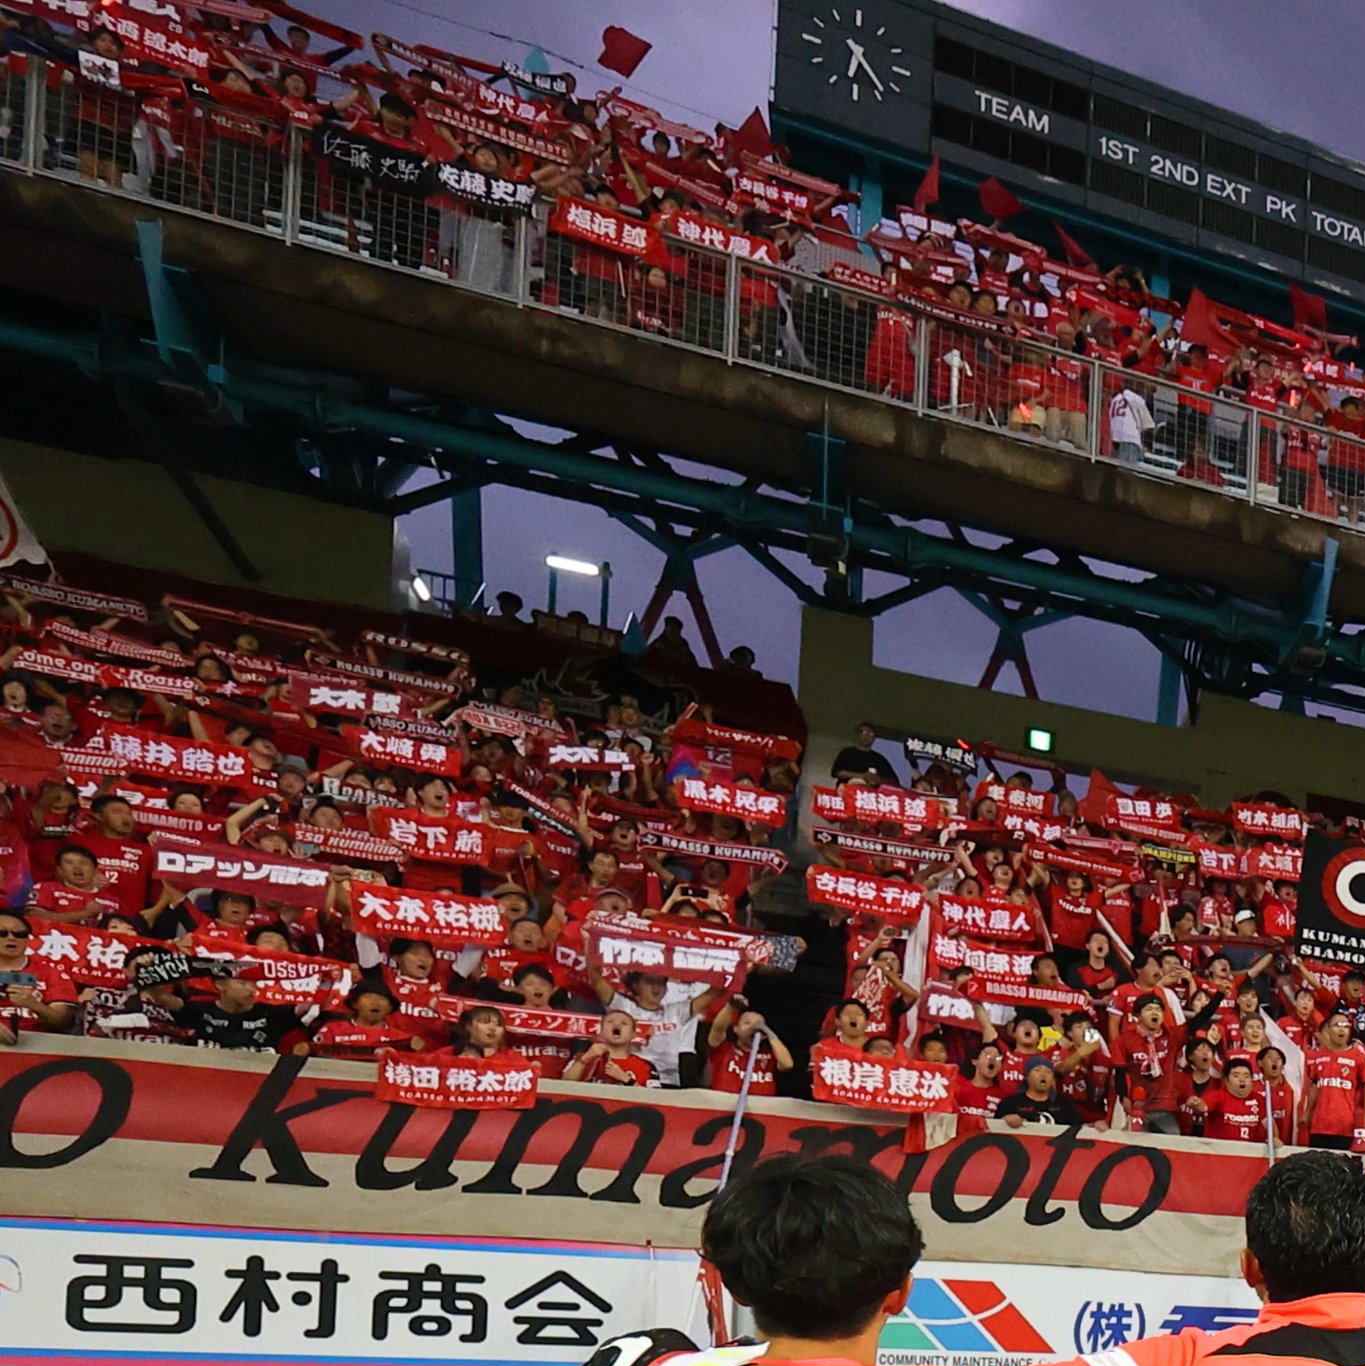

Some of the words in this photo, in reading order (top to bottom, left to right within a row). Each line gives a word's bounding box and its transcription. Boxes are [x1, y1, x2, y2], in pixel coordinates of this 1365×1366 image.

[974, 90, 1050, 135] TEAM
[1099, 136, 1140, 165] 1ST
[1149, 155, 1200, 187] 2ND
[1205, 174, 1252, 205] EXT
[1265, 195, 1296, 223] PK
[389, 817, 483, 853] 岩下航
[661, 835, 710, 856] ROASSO
[713, 844, 781, 865] KUMAMOTO
[837, 836, 884, 852] ROASSO
[887, 844, 951, 862] KUMAMOTO
[157, 850, 329, 886] ロアッソ熊本
[815, 872, 922, 909] 古長谷千博
[357, 890, 505, 933] 大本祐槻
[723, 975, 734, 988] 7
[985, 983, 1028, 999] ROASSO
[1028, 987, 1086, 1006] KUMAMOTO
[384, 1062, 534, 1093] 袴田裕太郎
[819, 1056, 950, 1099] 根岸恵汰
[190, 1053, 1171, 1230] kumaoto
[1239, 1126, 1250, 1139] 12
[66, 1252, 615, 1349] 西村商会
